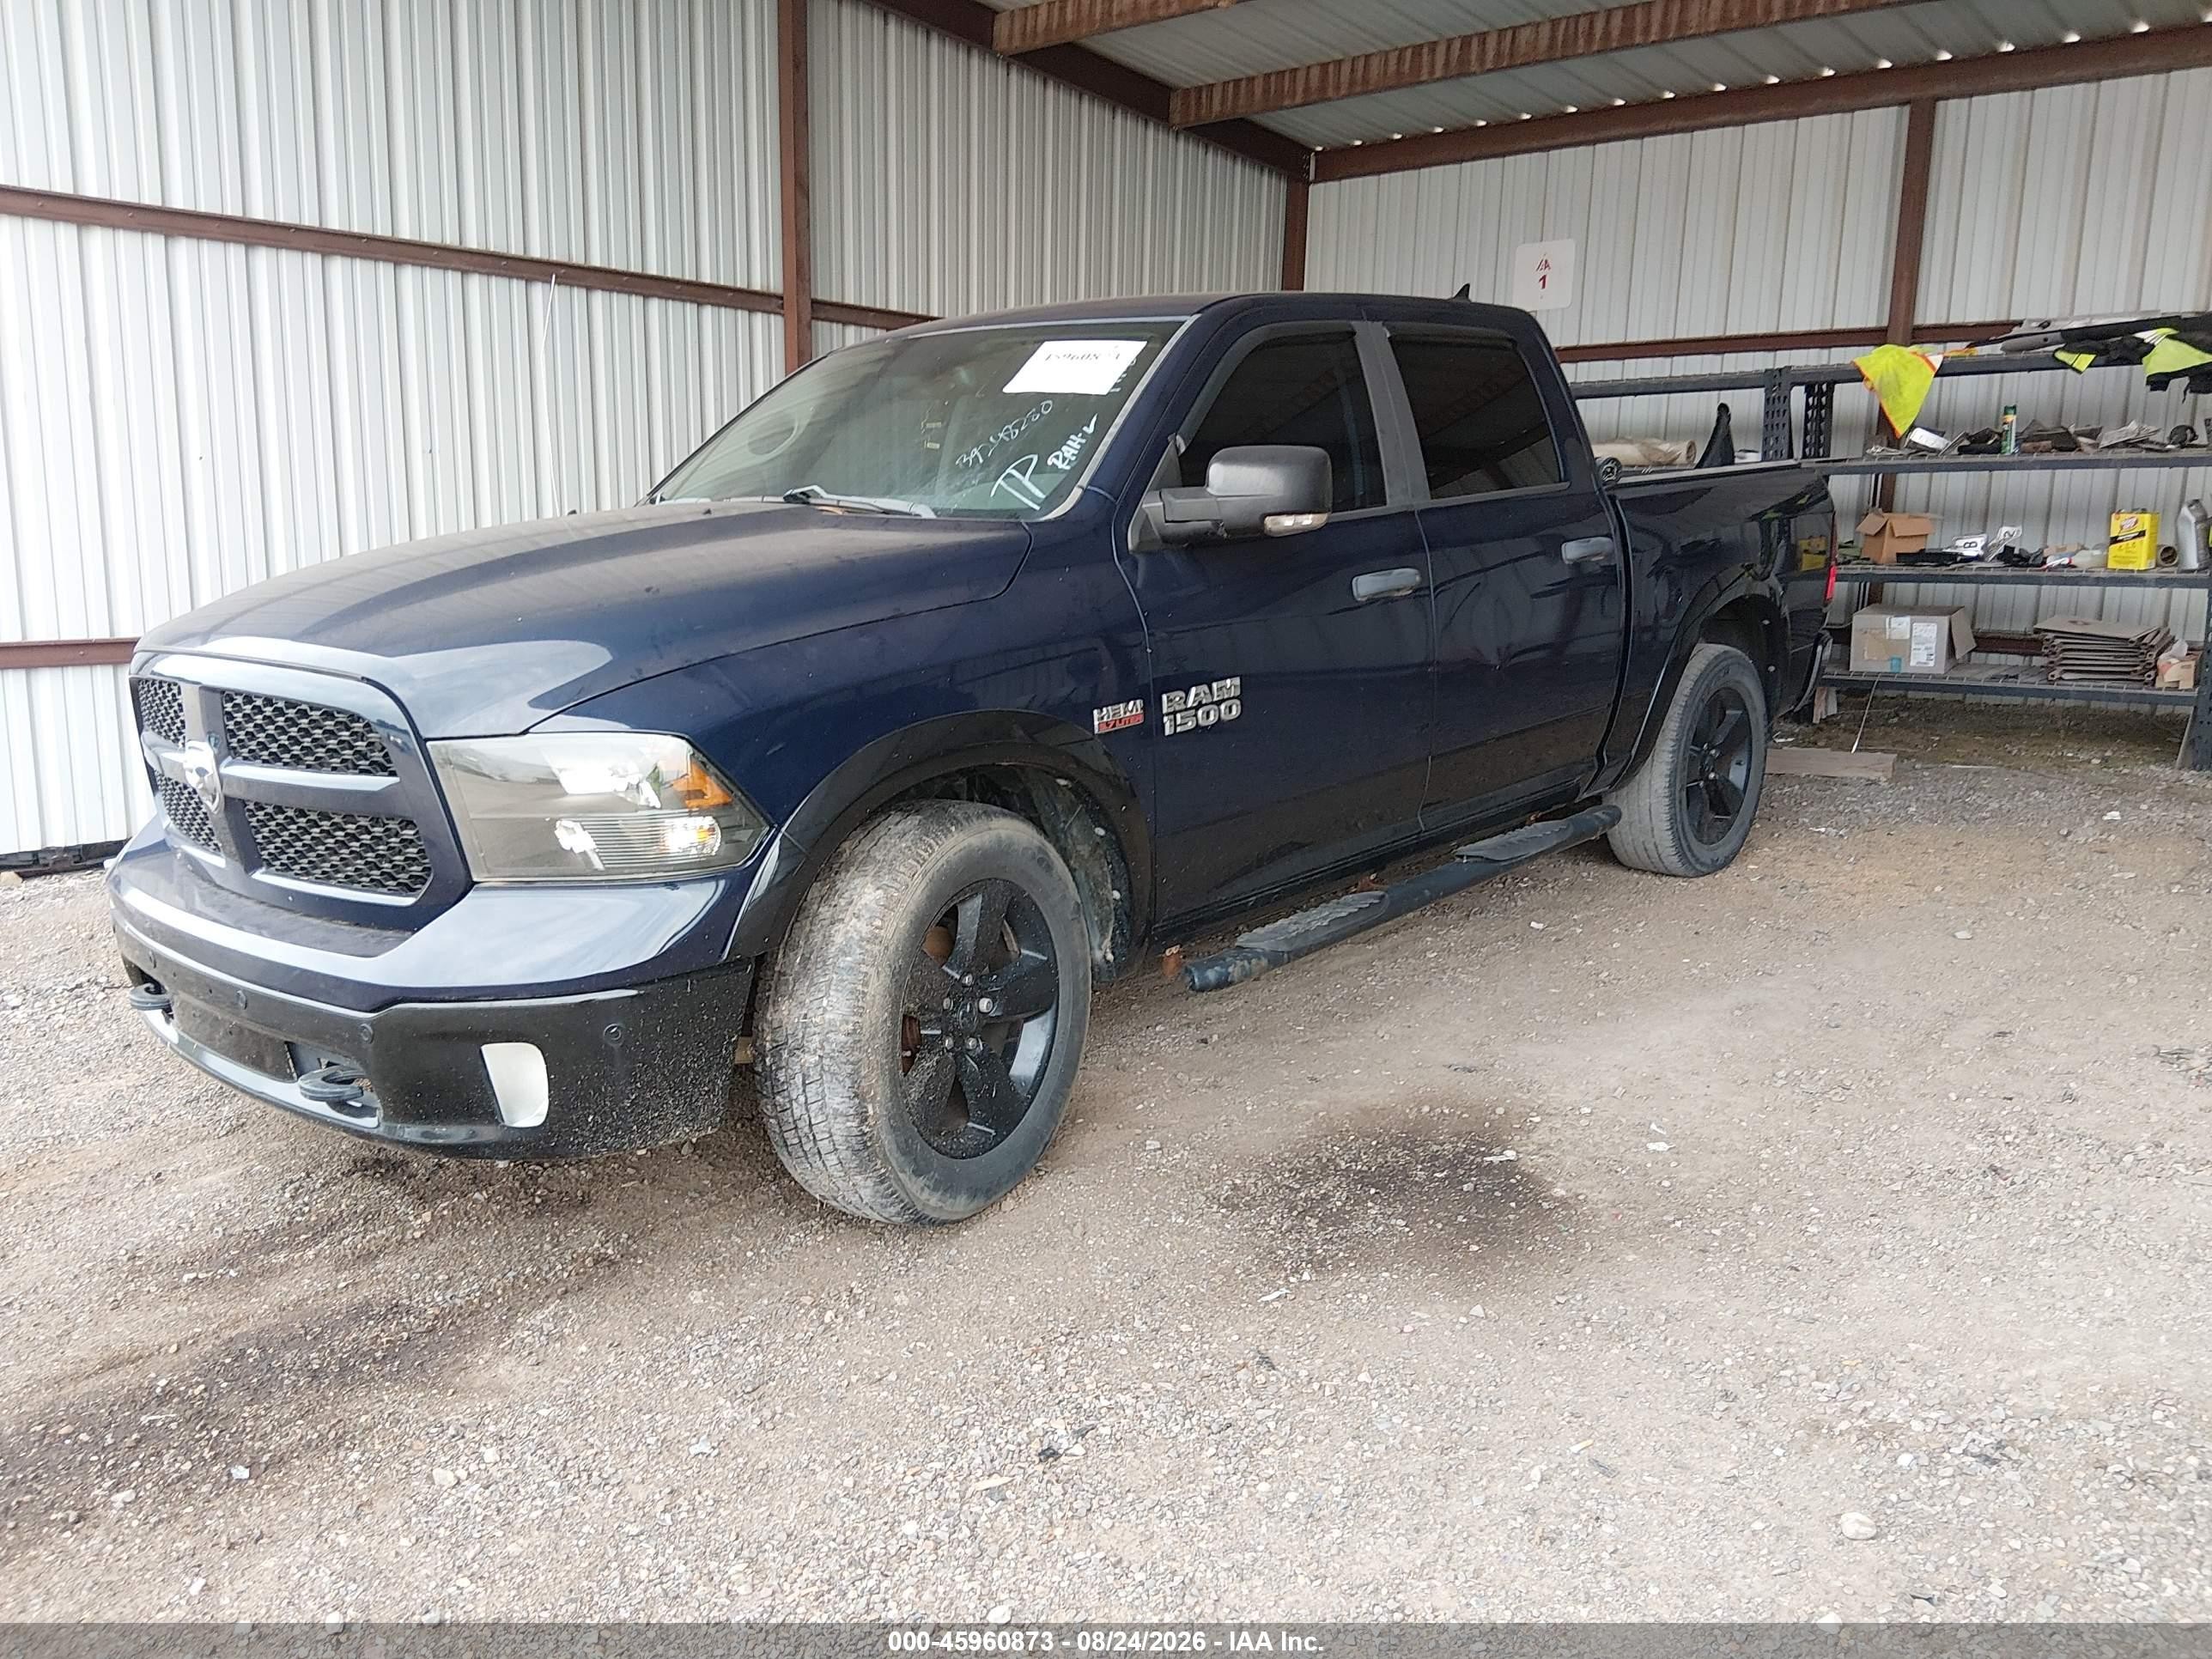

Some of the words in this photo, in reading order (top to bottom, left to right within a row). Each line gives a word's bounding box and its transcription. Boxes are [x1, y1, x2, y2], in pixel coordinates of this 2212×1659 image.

[1538, 274, 1547, 289] 1
[1162, 677, 1241, 714] RAM
[1163, 698, 1242, 736] 1500
